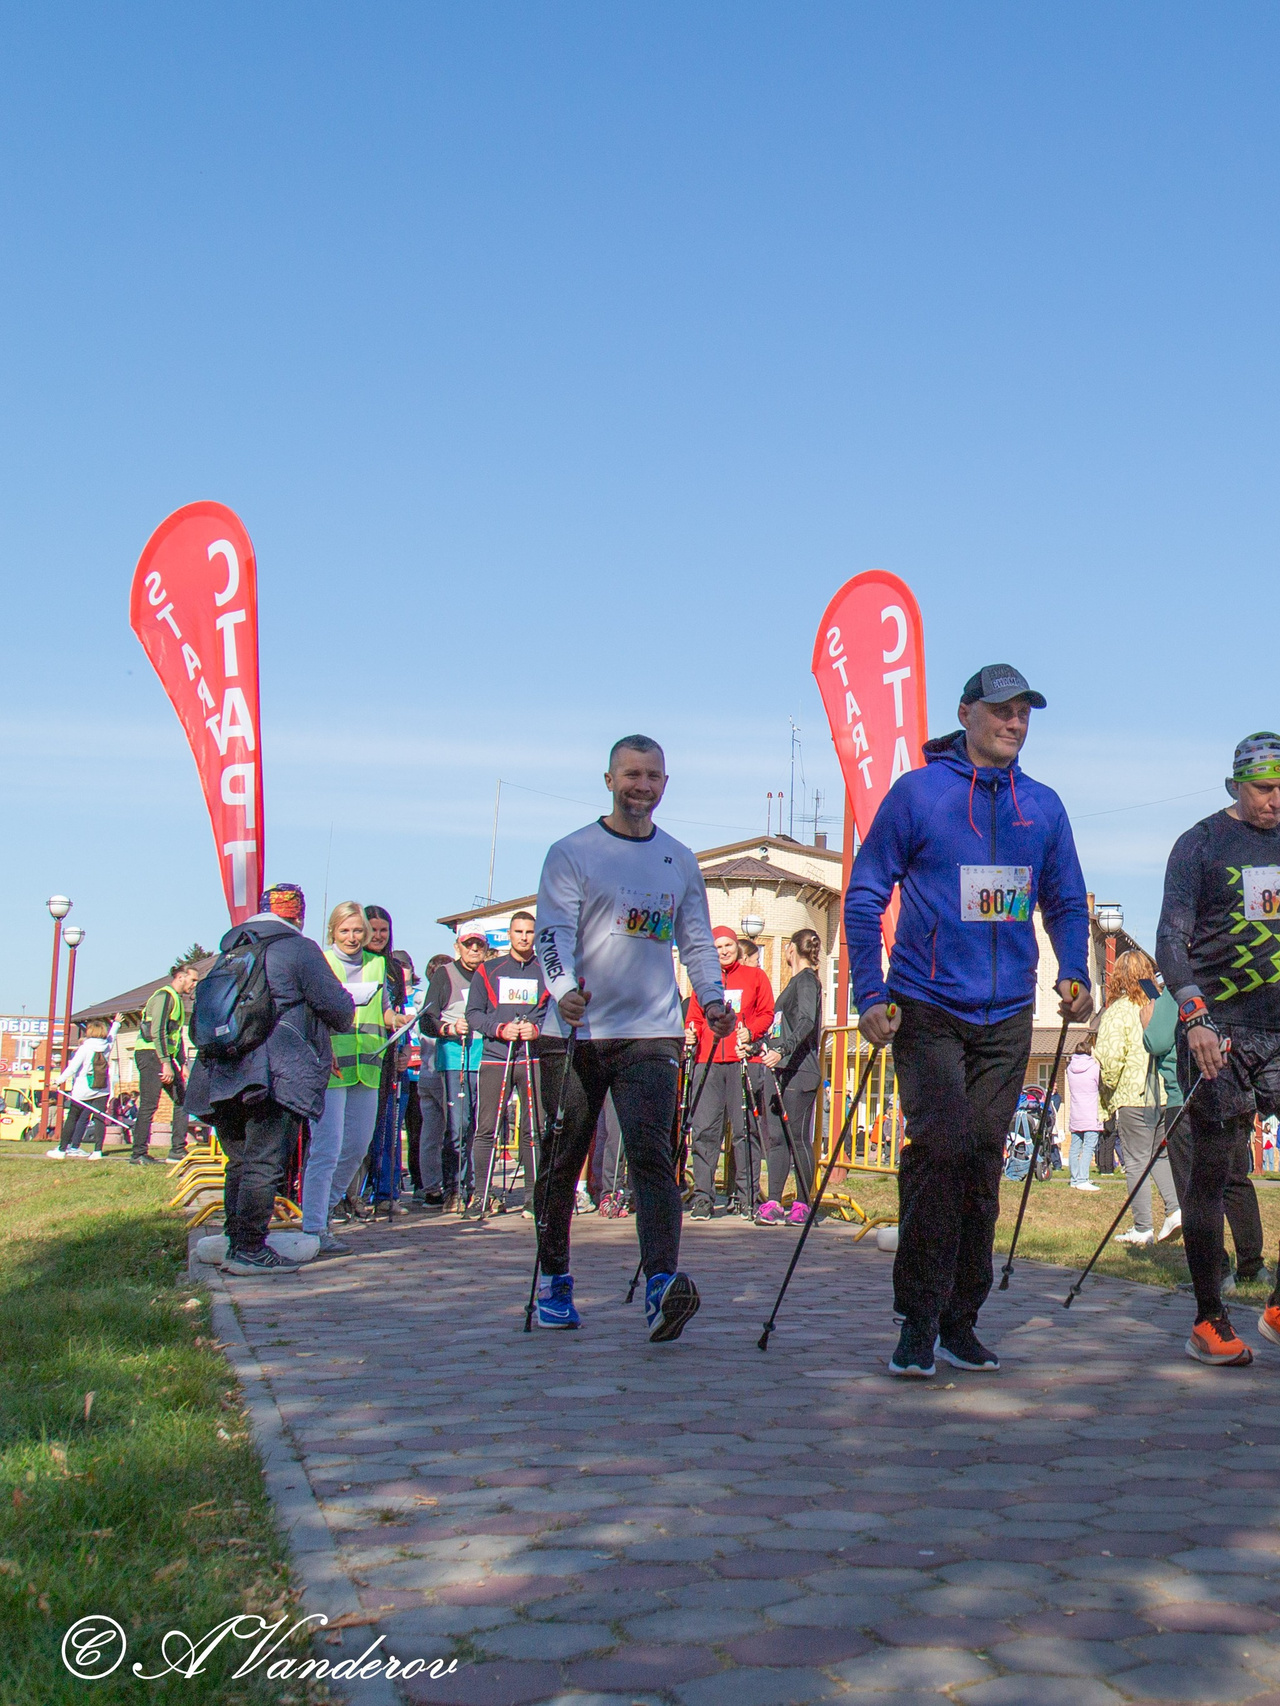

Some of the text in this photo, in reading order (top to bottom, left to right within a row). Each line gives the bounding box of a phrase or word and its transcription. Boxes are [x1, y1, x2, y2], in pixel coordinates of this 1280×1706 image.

[980, 888, 1017, 915] 807
[627, 907, 662, 933] 829
[543, 944, 566, 984] YONEX
[508, 988, 529, 1001] 840
